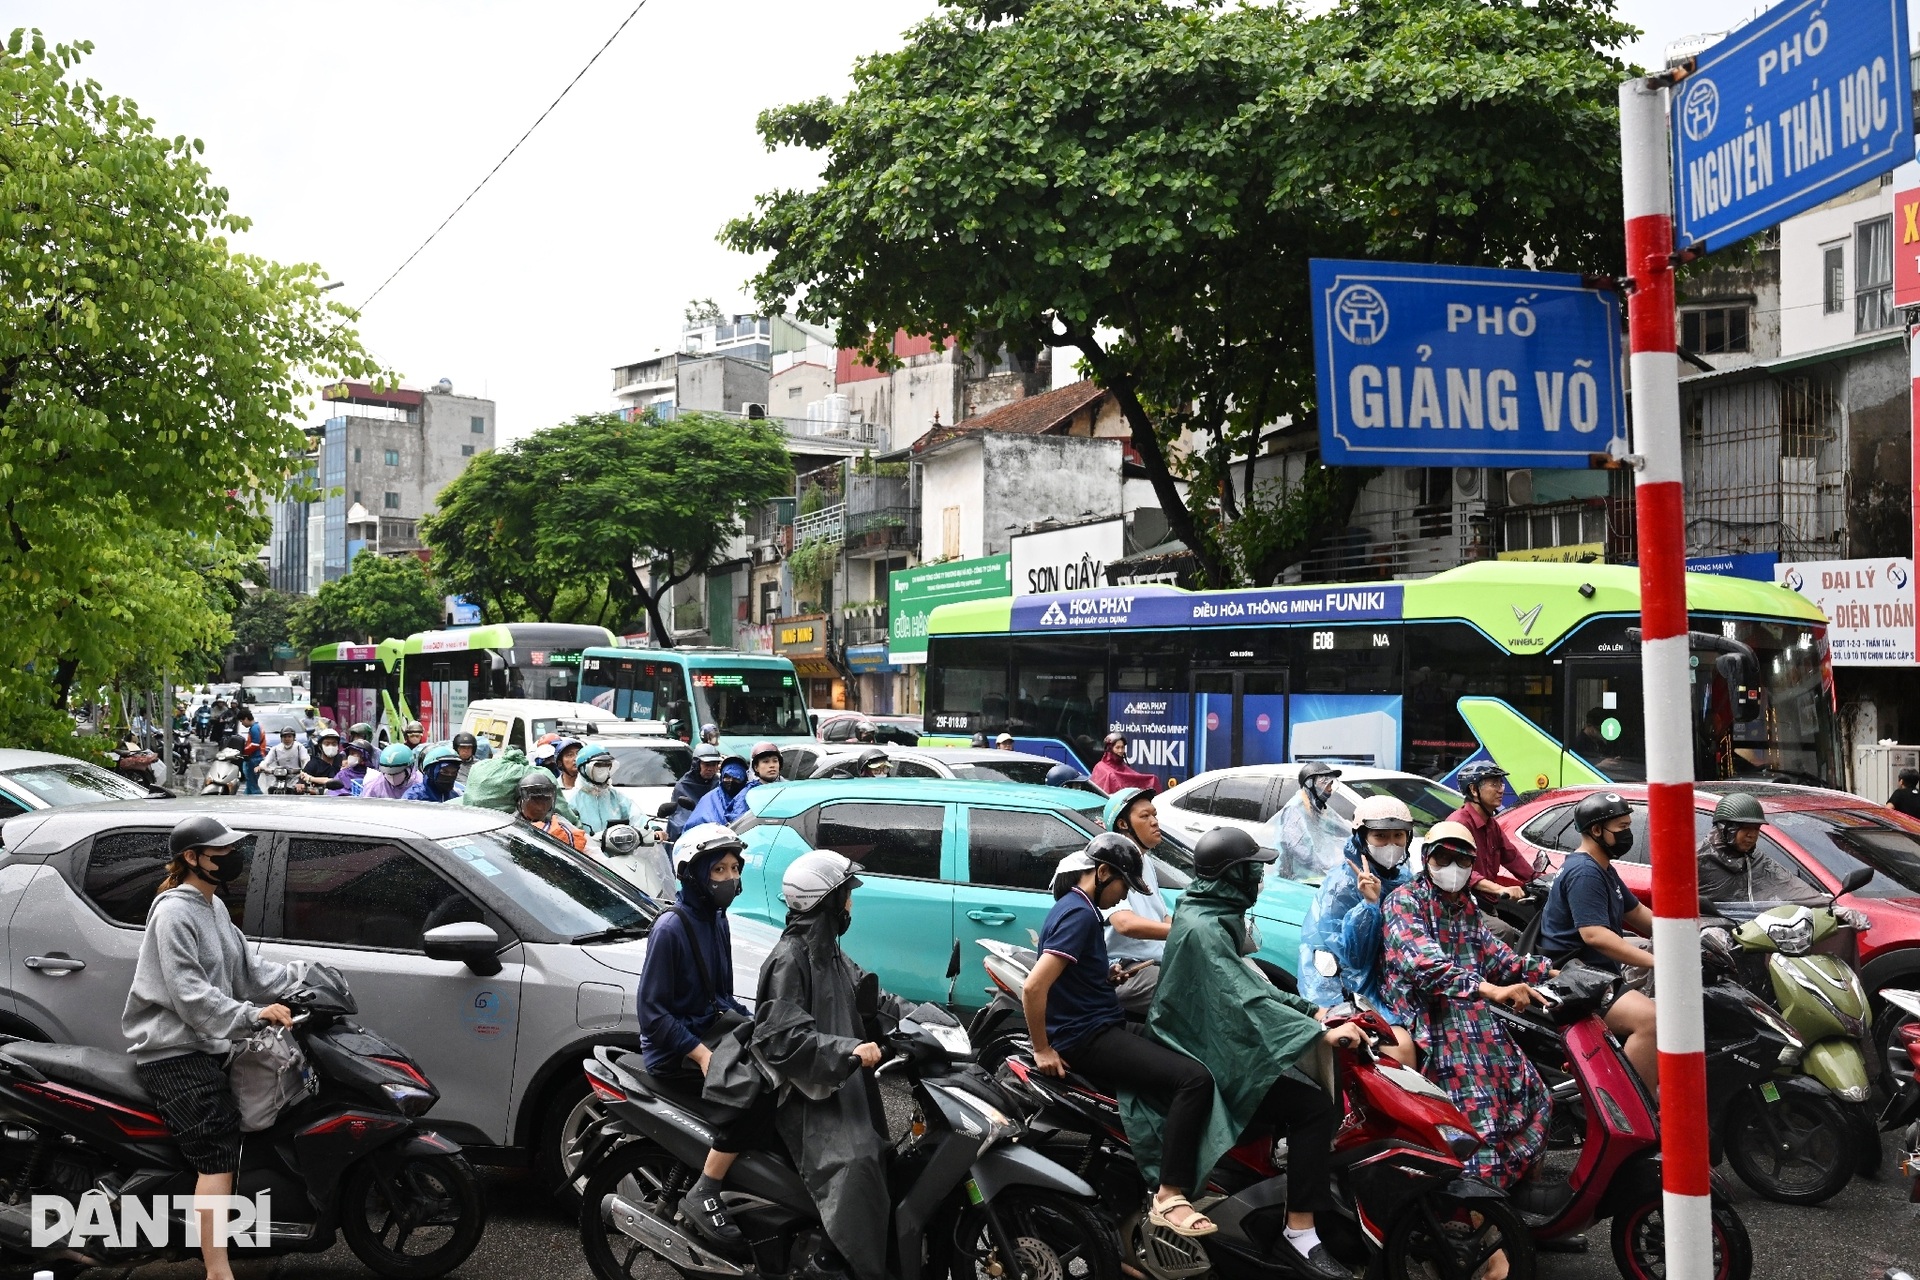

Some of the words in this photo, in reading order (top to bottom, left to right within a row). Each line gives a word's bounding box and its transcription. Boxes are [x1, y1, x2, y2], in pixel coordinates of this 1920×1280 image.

[1758, 0, 1828, 87] PHỐ
[1690, 104, 1772, 221] NGUYỄN
[1779, 80, 1834, 178] THÁI
[1841, 55, 1888, 156] HỌC
[1903, 201, 1920, 244] X
[1446, 292, 1537, 337] PHỐ
[1349, 345, 1518, 431] GIẢNG
[1535, 359, 1599, 433] VÕ
[1725, 561, 1733, 569] VÀ
[1028, 566, 1059, 594] SƠN
[1822, 571, 1851, 593] ĐẠI
[1856, 565, 1876, 589] LÝ
[1193, 601, 1218, 618] ĐIỀU
[1220, 601, 1245, 616] HÒA
[1247, 599, 1288, 614] THÔNG
[1291, 599, 1323, 613] MINH
[1326, 591, 1385, 611] FUNIKI
[1836, 599, 1870, 632] ĐIỆN
[1874, 598, 1914, 628] TOÁN
[912, 610, 929, 637] HÀN
[1109, 615, 1127, 625] DỤNG
[1313, 632, 1334, 650] E08
[1373, 634, 1390, 647] NA
[1508, 637, 1544, 646] VINBUS
[1598, 643, 1610, 652] CỬA
[1611, 643, 1624, 652] LÊN
[936, 716, 968, 729] 29F-018.09
[1110, 720, 1125, 732] ĐIỀU
[1126, 722, 1140, 733] HÒA
[1142, 723, 1166, 733] THÔNG
[1124, 739, 1185, 767] UNIKI
[955, 1128, 981, 1140] HONDA
